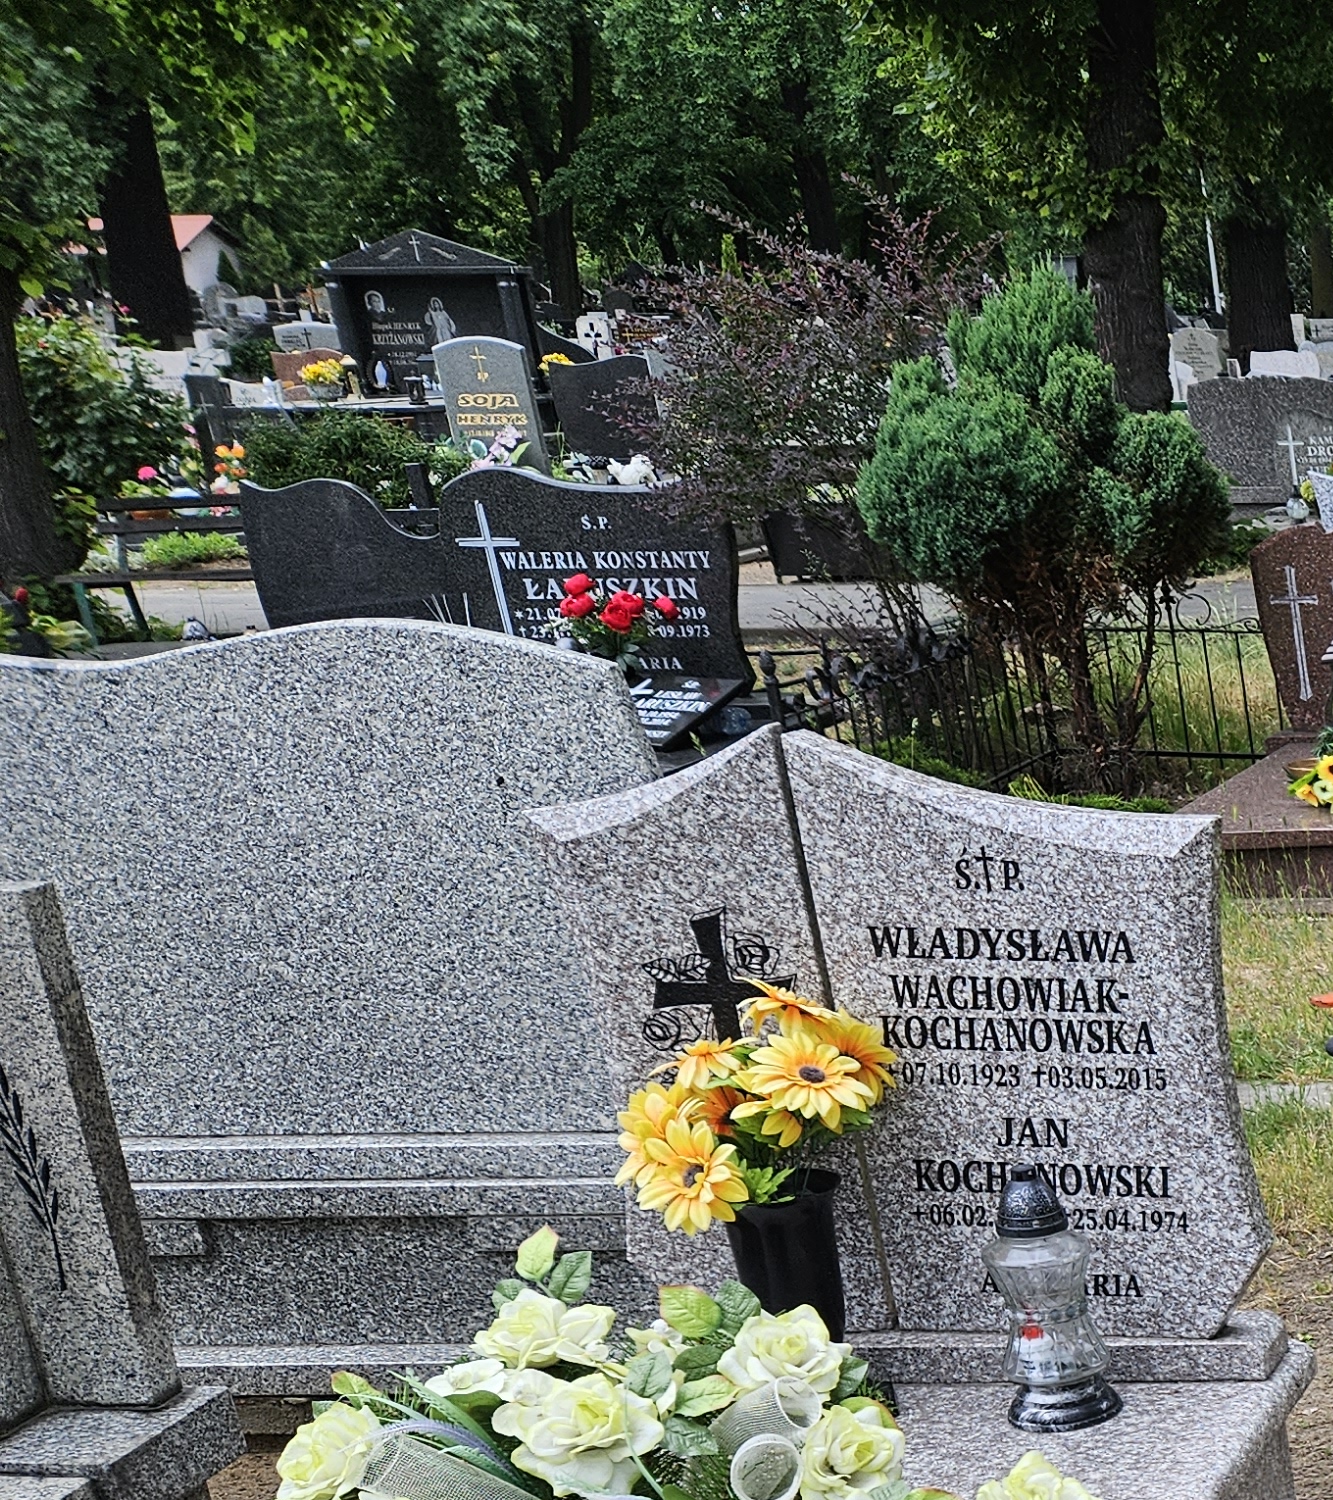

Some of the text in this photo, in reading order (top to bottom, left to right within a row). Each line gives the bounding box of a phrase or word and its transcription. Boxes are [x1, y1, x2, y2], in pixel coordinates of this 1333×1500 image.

[458, 393, 519, 409] SOJA
[457, 414, 528, 425] HENRYK
[581, 514, 612, 530] Ś.P.
[500, 550, 711, 570] WALERIA KONSTANTY
[523, 578, 699, 600] ŁASZKIN
[638, 657, 684, 670] ARIA
[867, 926, 1135, 963] WŁADYSŁAWA
[891, 975, 1129, 1013] WACHOWIAK-
[880, 1015, 1156, 1054] KOCHANOWSKA
[997, 1117, 1069, 1148] JAN
[914, 1159, 1170, 1198] KOCHNOWSKI
